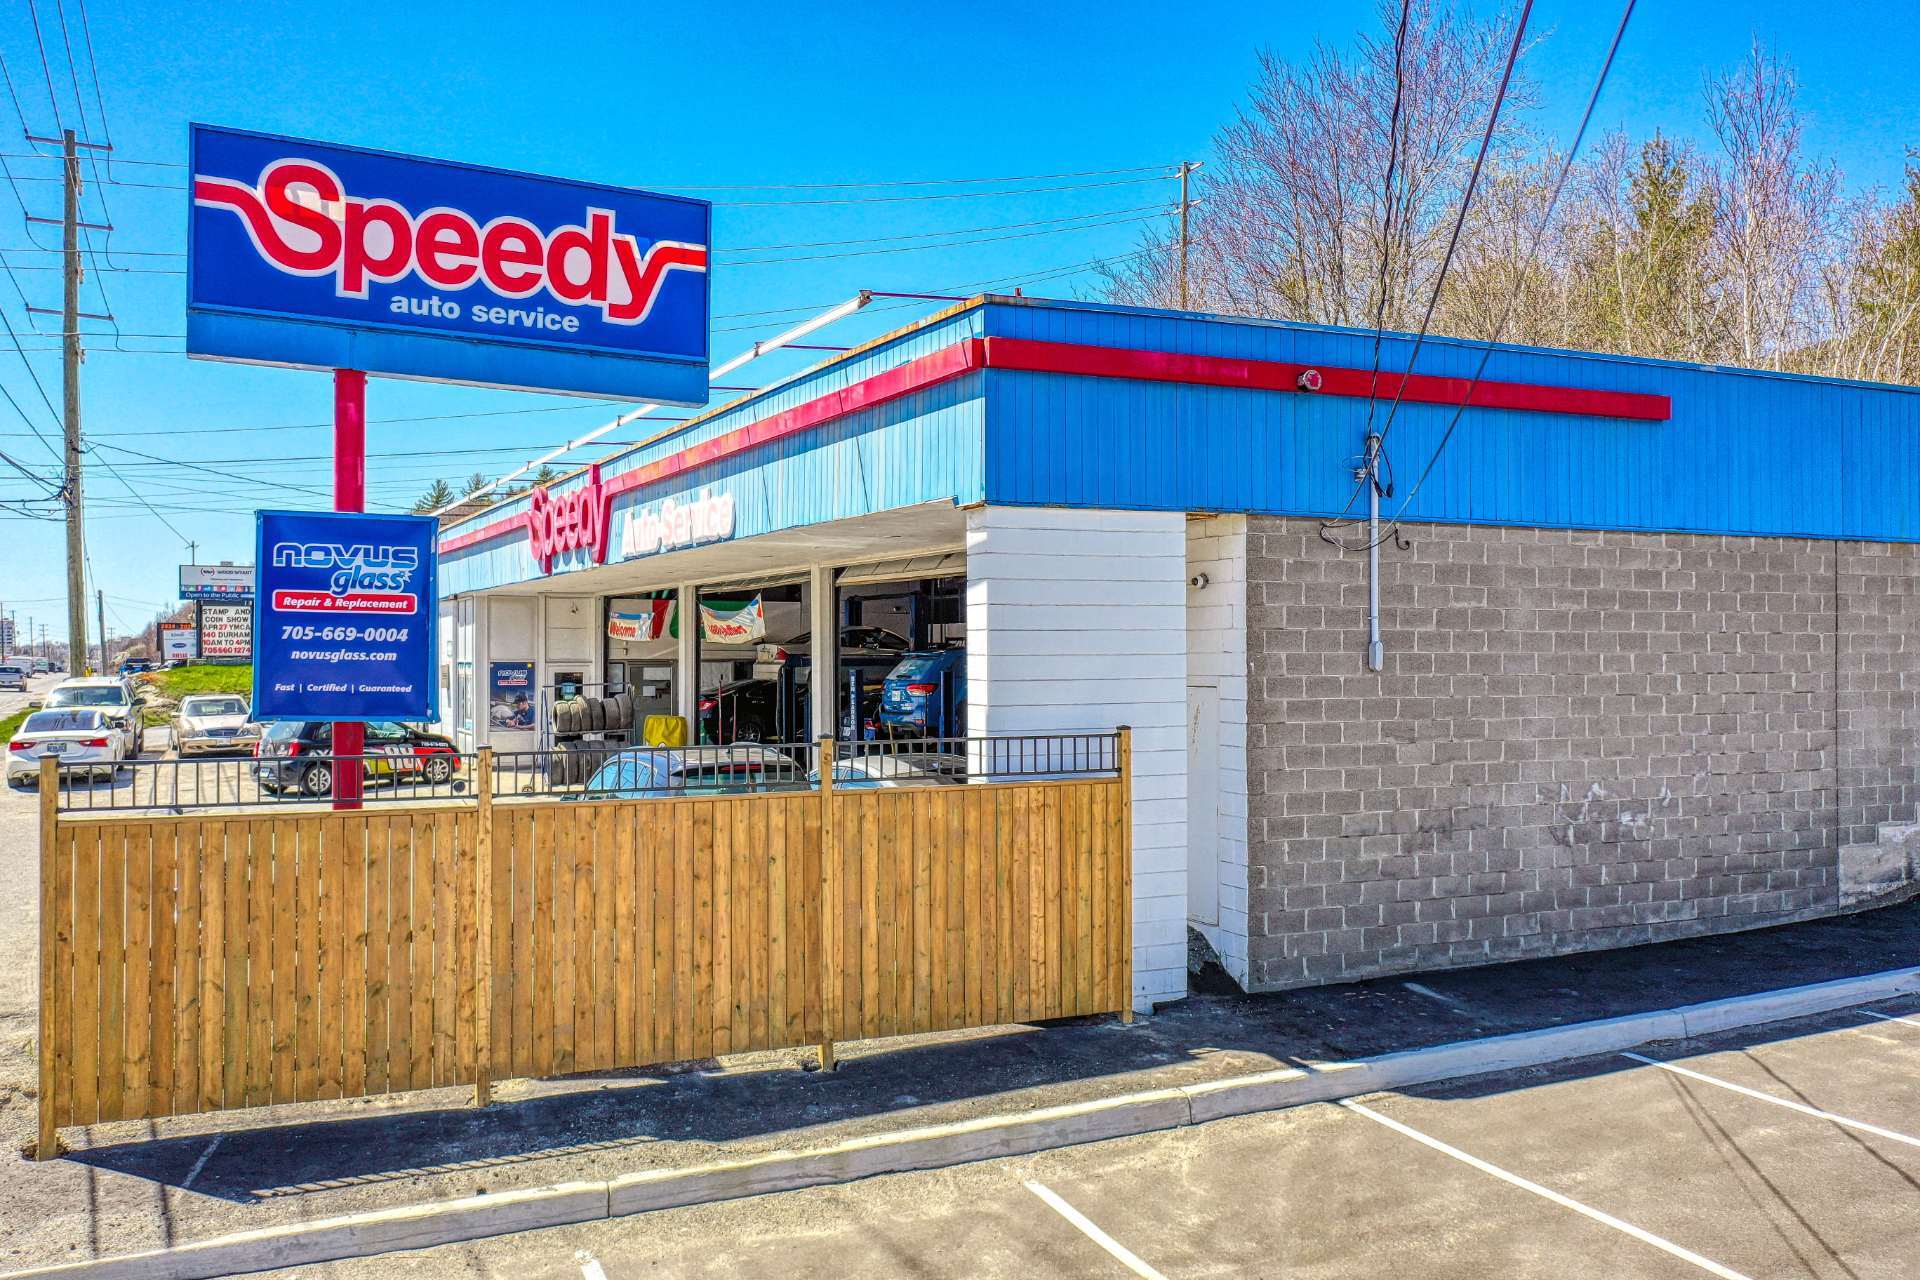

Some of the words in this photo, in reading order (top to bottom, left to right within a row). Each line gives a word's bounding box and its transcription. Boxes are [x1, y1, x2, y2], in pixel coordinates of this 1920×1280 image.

[250, 157, 670, 326] Speedy
[389, 295, 461, 320] auto
[471, 303, 580, 333] service
[528, 464, 612, 576] Speedy
[330, 565, 405, 597] glass
[283, 597, 320, 609] Repair
[324, 598, 332, 606] &
[335, 598, 408, 610] Replacement
[281, 625, 409, 642] 705-669-0004
[291, 649, 397, 663] novusglass.com
[274, 683, 295, 692] Fast
[306, 683, 347, 692] Certified
[359, 684, 413, 693] Guaranteed
